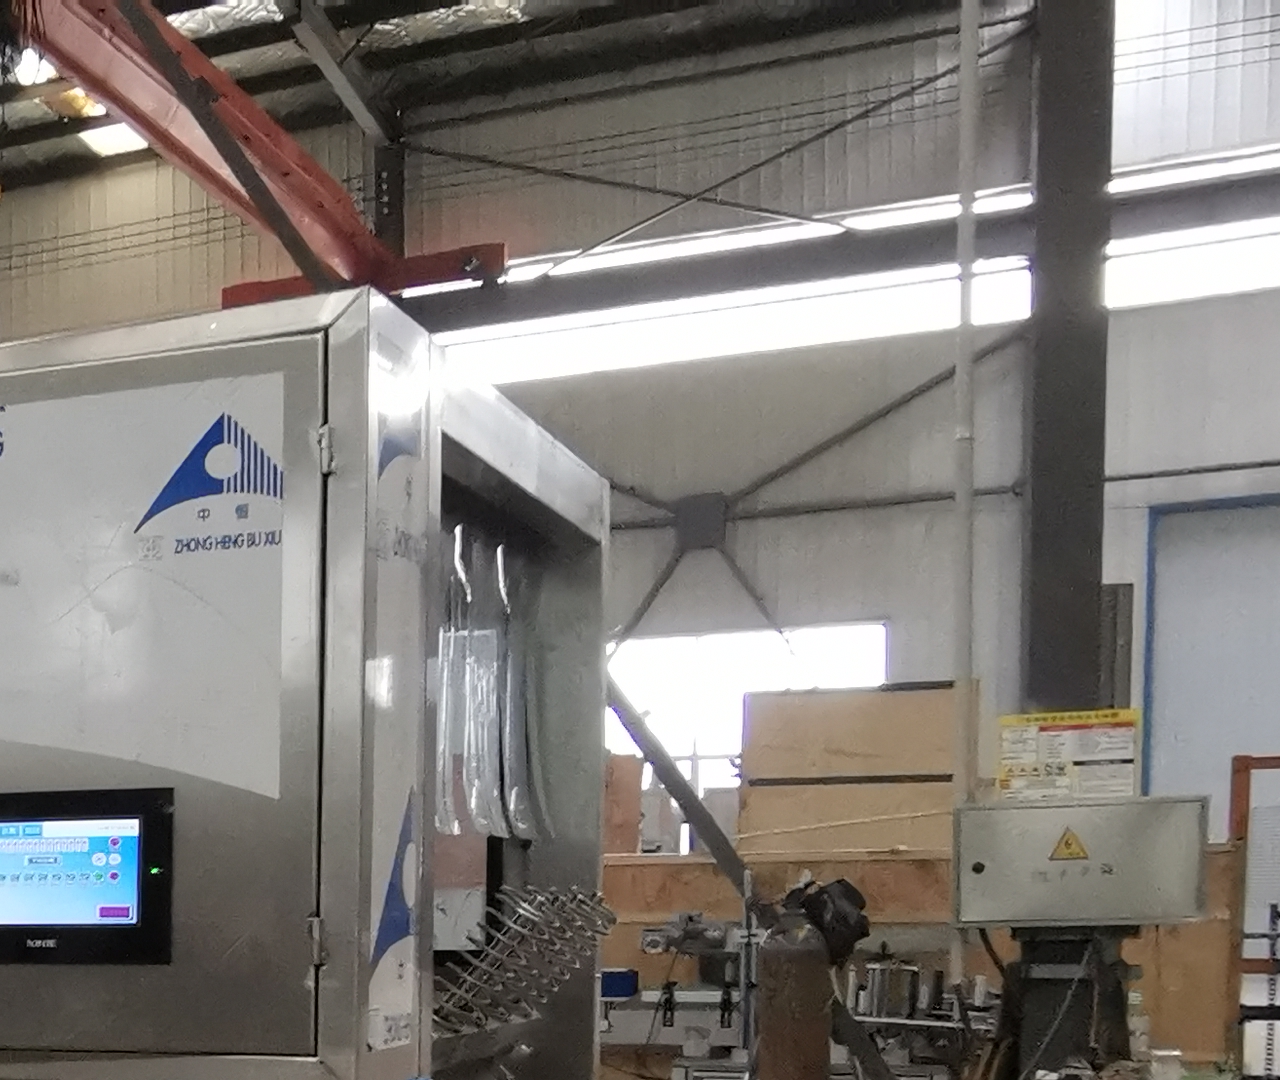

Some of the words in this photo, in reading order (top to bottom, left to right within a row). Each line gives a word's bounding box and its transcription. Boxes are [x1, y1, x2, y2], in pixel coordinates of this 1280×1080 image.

[174, 536, 212, 554] ZHONG
[214, 533, 244, 550] HENG
[246, 530, 260, 548] BU
[263, 529, 282, 546] XIU
